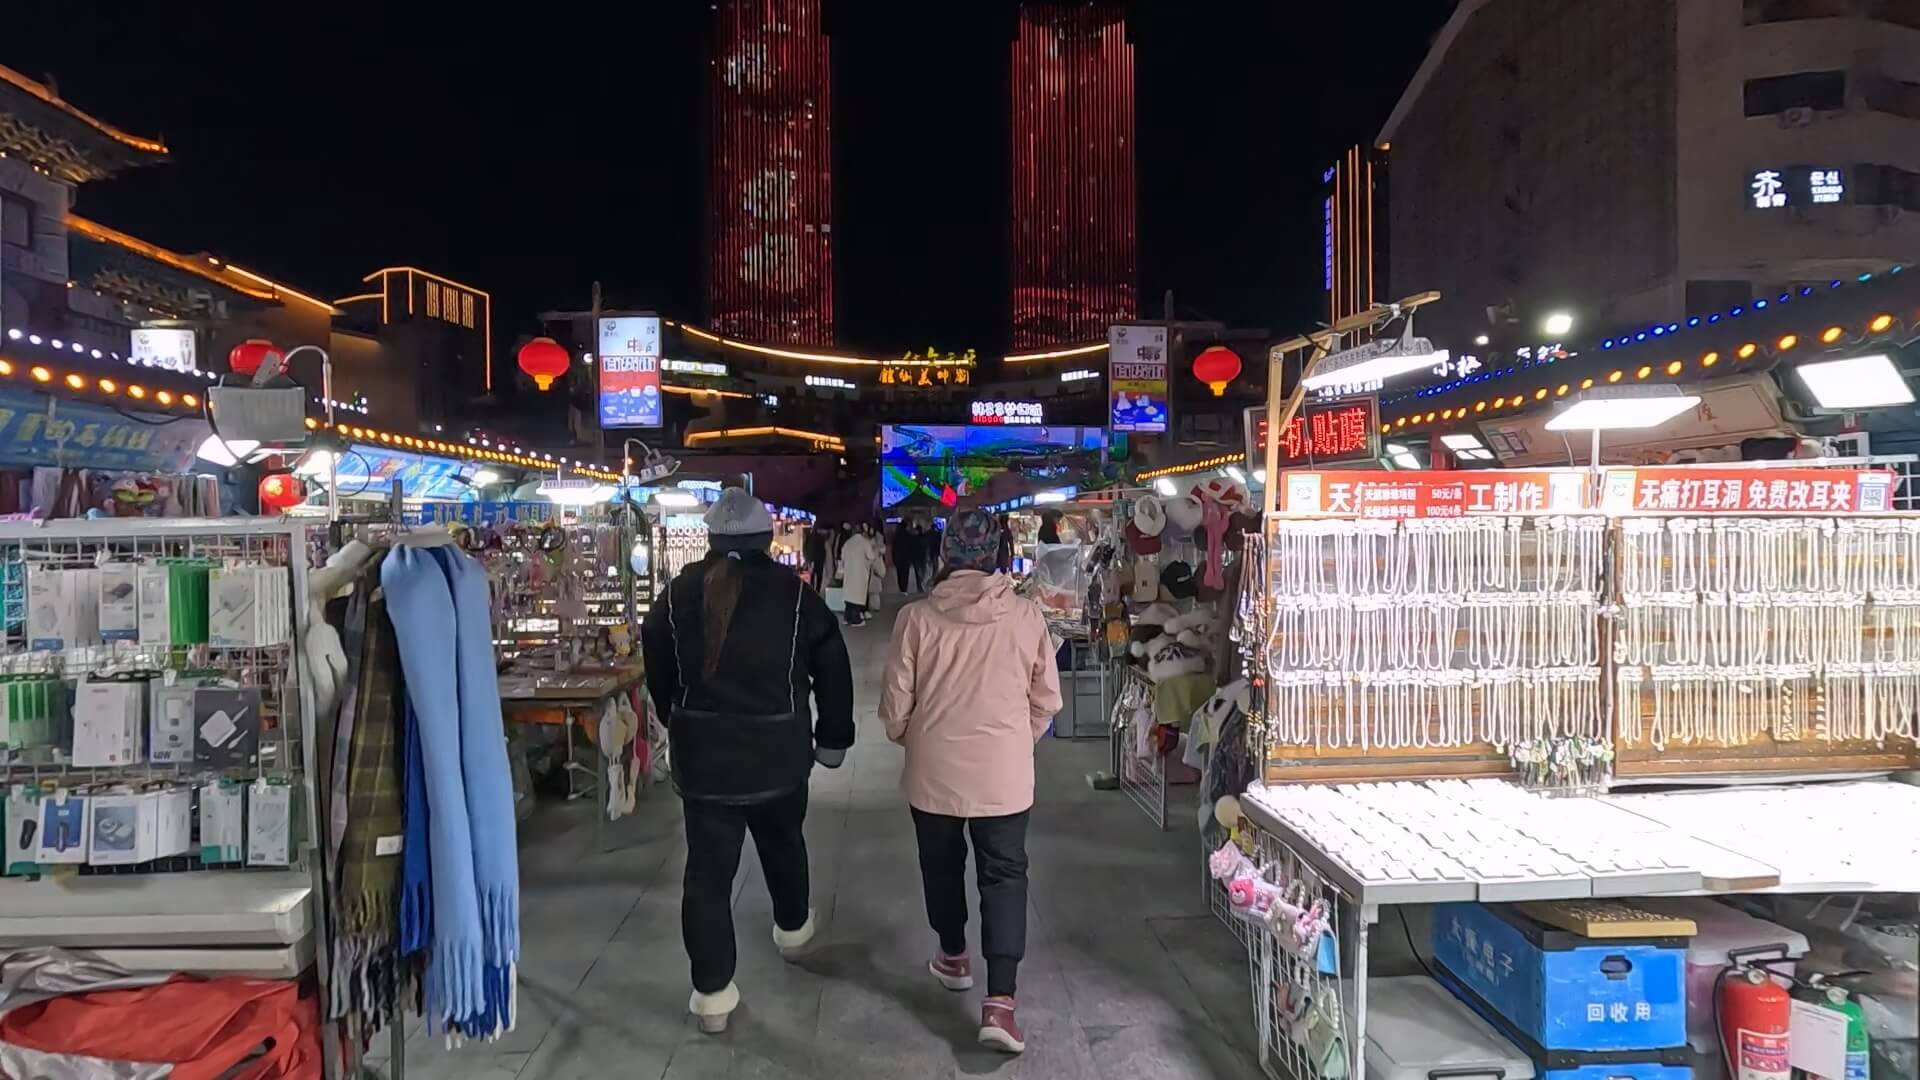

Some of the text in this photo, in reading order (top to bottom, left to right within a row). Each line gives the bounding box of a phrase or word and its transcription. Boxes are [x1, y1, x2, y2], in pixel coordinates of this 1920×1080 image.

[1639, 479, 1850, 510] 无痛打耳洞 免费改耳夹
[1587, 1002, 1651, 1022] 回收用
